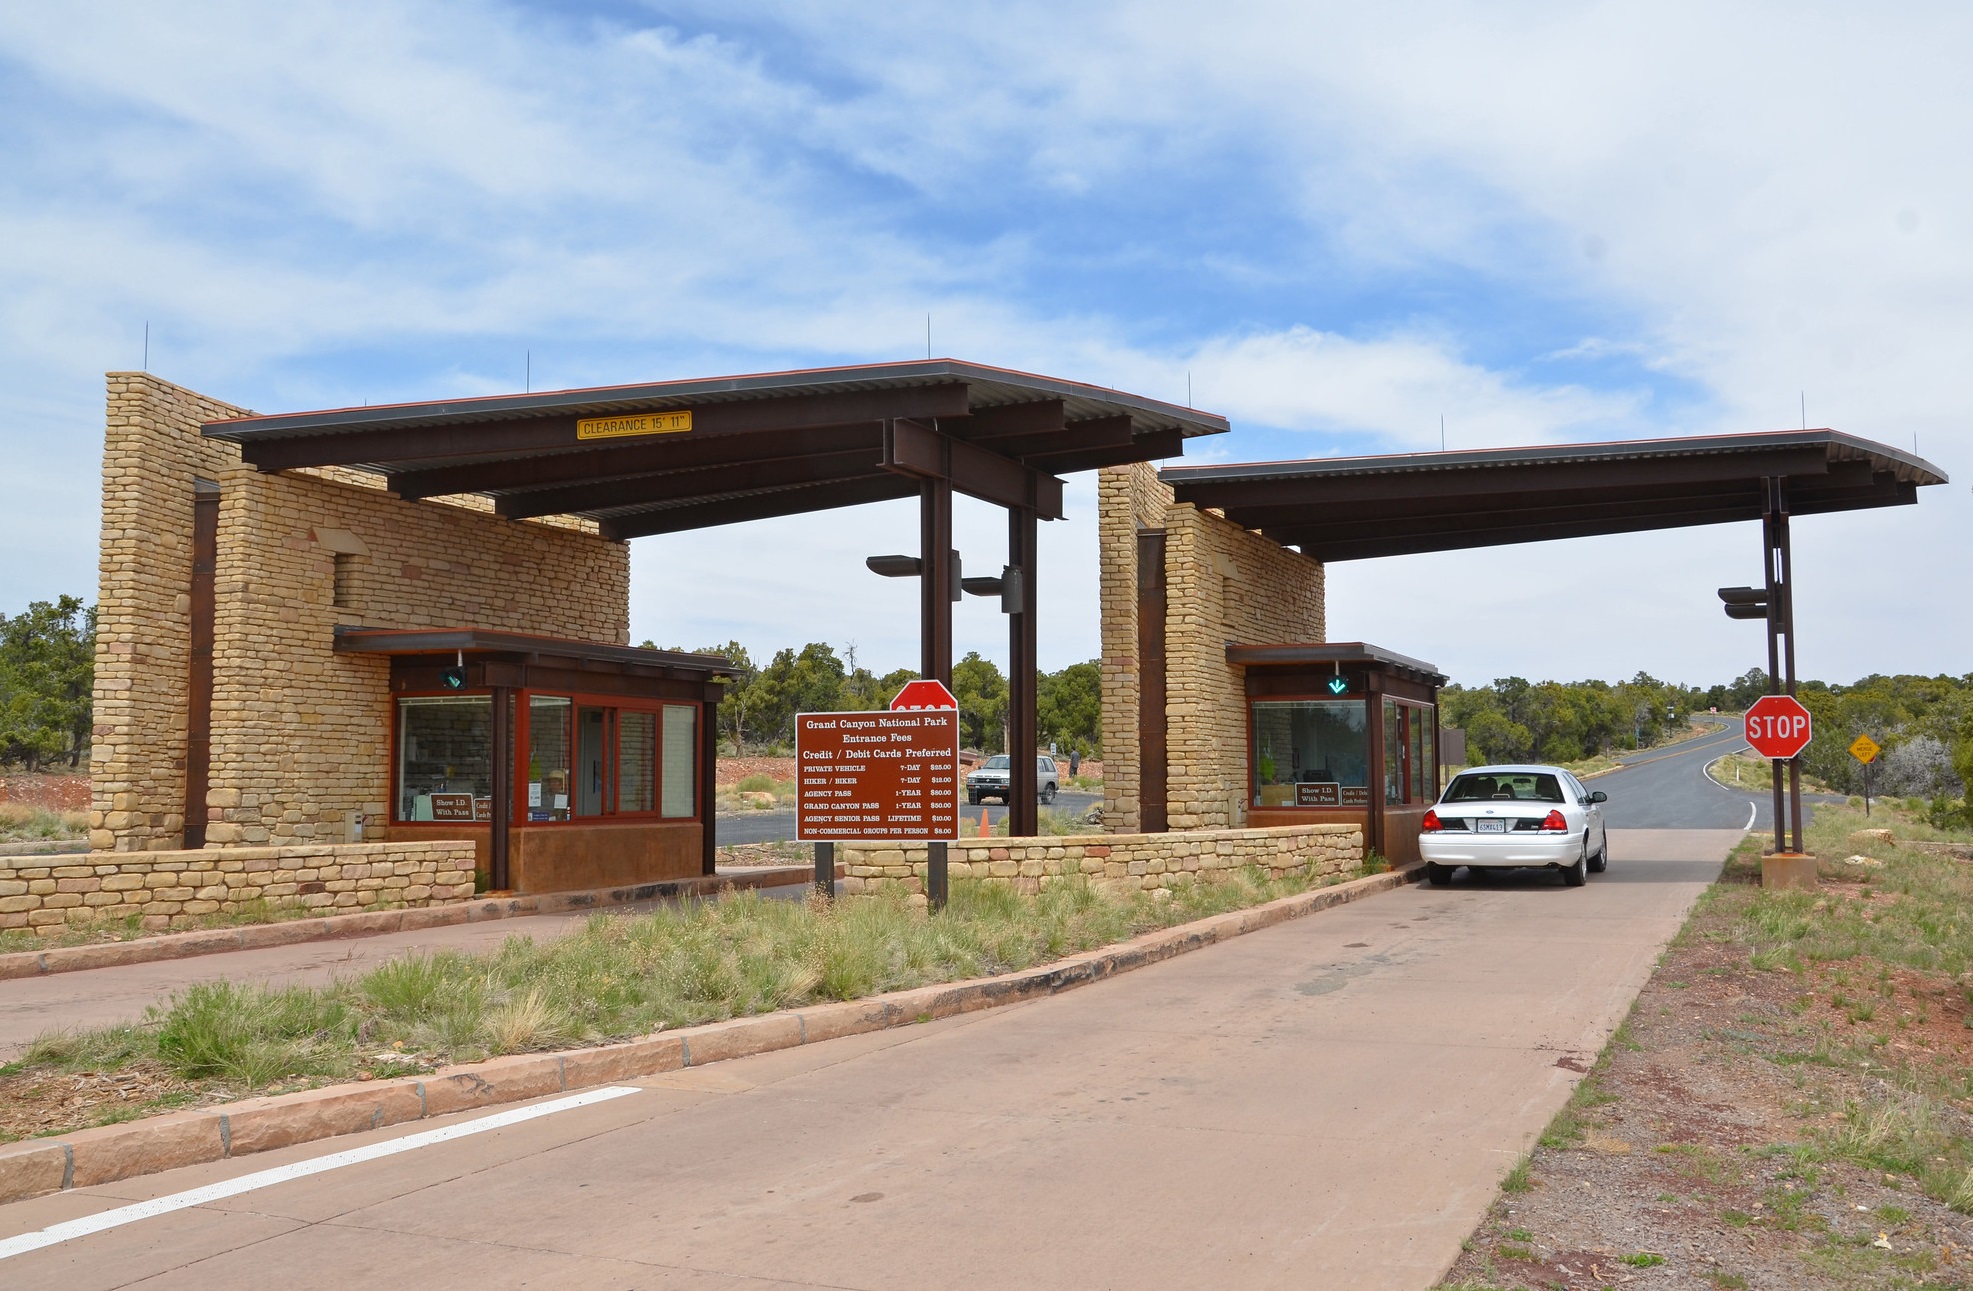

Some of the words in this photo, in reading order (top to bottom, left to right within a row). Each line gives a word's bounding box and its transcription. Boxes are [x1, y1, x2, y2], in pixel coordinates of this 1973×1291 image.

[584, 419, 646, 434] CLEARANCE
[806, 720, 836, 729] Grand
[840, 719, 876, 730] Canyon
[879, 718, 920, 727] National
[924, 717, 947, 726] Park
[1749, 715, 1806, 738] STOP
[843, 734, 887, 743] Entrance
[891, 733, 912, 742] Fees
[803, 750, 833, 759] Credit
[846, 749, 871, 759] Debit
[874, 749, 902, 758] Cards
[906, 748, 951, 757] Preferred
